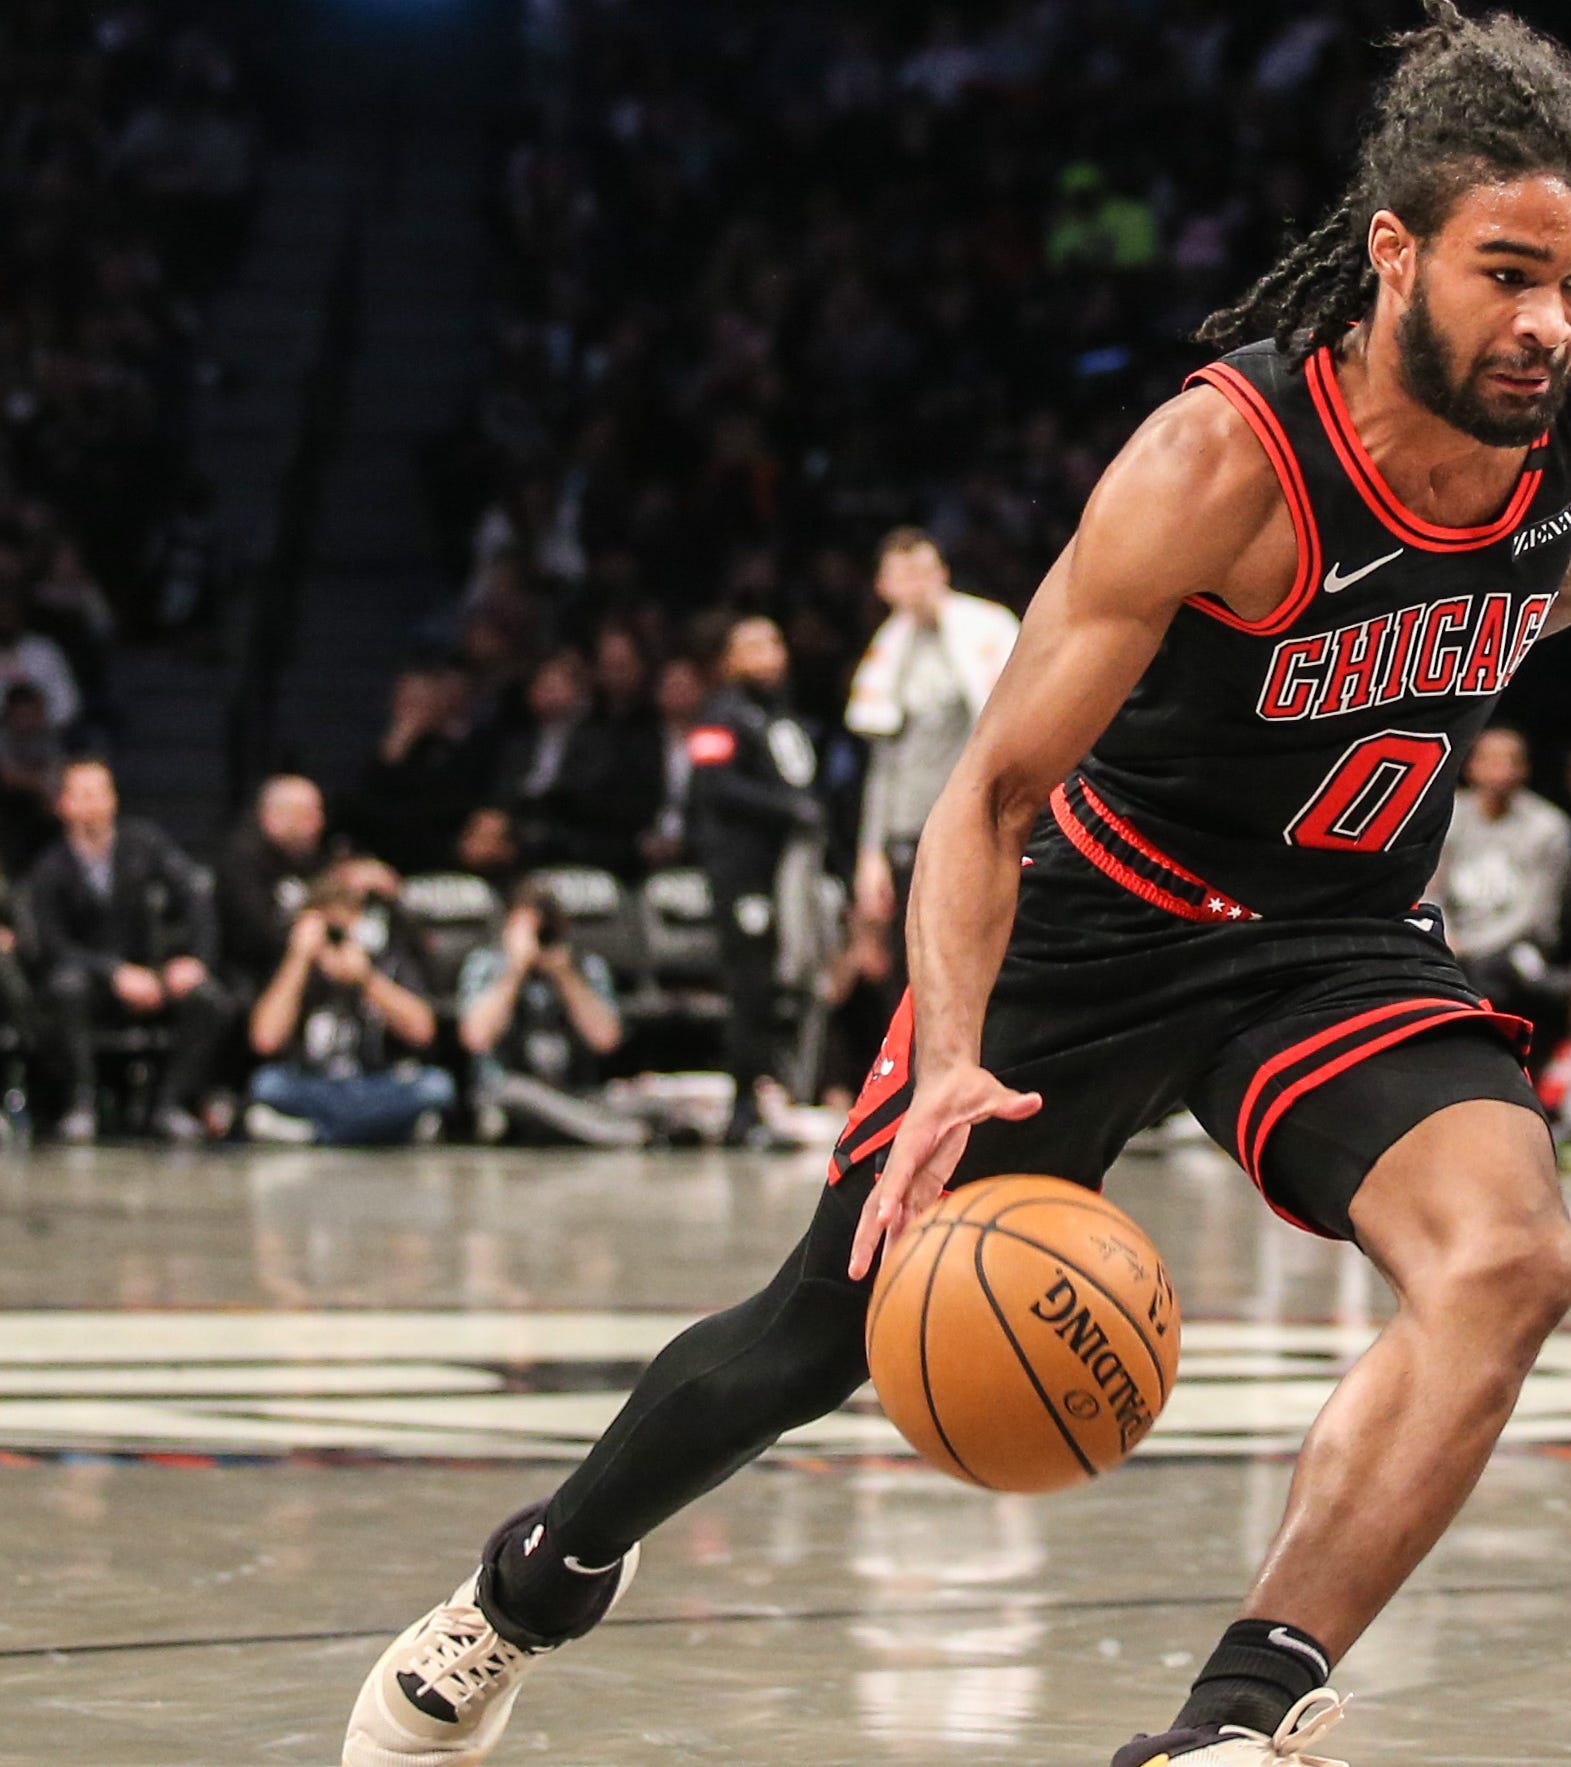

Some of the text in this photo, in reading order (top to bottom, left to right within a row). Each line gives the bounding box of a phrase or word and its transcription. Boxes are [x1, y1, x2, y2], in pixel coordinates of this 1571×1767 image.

[1256, 591, 1559, 722] CHICAG
[1283, 728, 1452, 853] 0
[1030, 1275, 1154, 1455] PALDING
